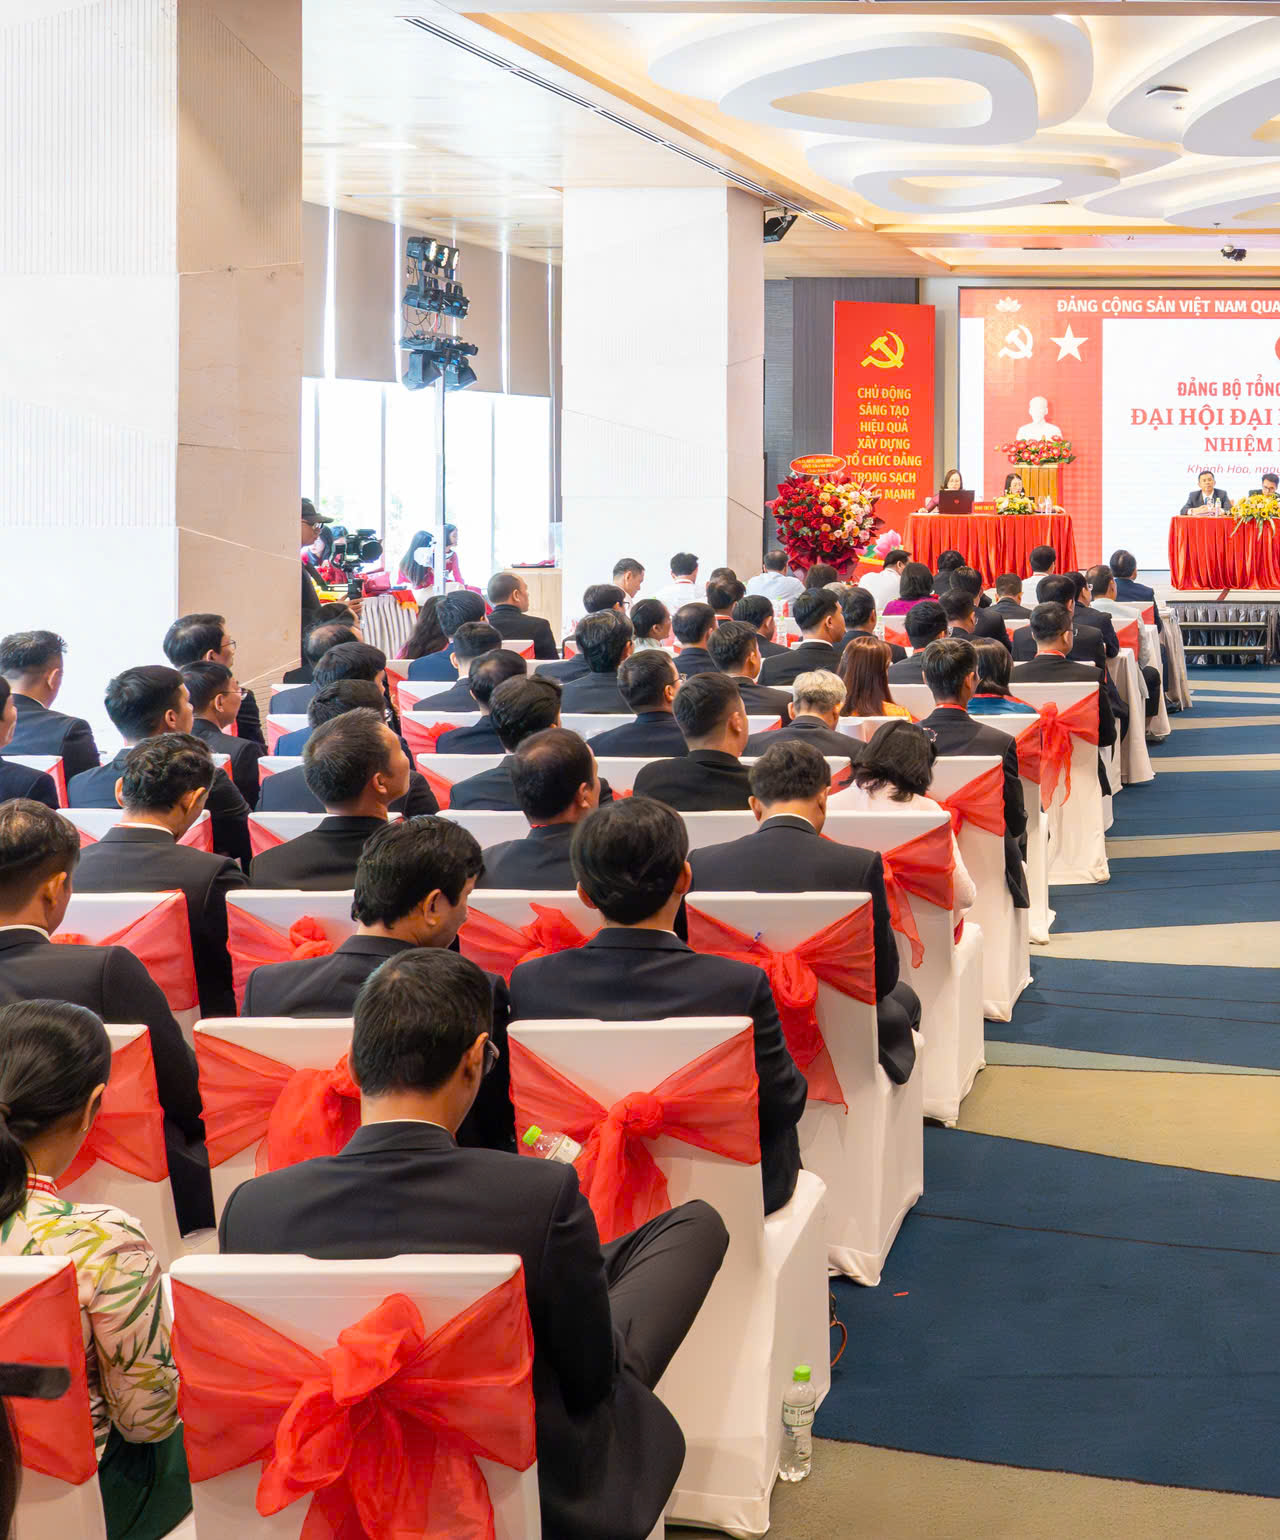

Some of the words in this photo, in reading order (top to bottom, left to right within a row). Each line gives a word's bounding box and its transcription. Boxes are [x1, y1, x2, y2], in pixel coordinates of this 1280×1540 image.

[1057, 296, 1098, 312] ĐẢNG
[1102, 296, 1142, 316] CỘNG
[1146, 296, 1175, 312] SẢN
[1179, 296, 1210, 316] VIỆT
[1215, 300, 1247, 312] NAM
[858, 384, 879, 398] CHỦ
[882, 386, 911, 402] ĐỘNG
[1177, 376, 1218, 396] ĐẢNG
[1222, 378, 1241, 400] BỘ
[859, 402, 887, 416] SÁNG
[890, 405, 909, 419] TẠO
[1130, 408, 1174, 430] ĐẠI
[1179, 404, 1224, 430] HỘI
[1230, 408, 1273, 430] ĐẠI
[860, 419, 884, 435] HIỆU
[887, 418, 908, 433] QUẢ
[858, 435, 878, 448] XÂY
[880, 439, 910, 452] DỰNG
[1204, 434, 1273, 456] NHIỆM
[846, 450, 859, 466] TỔ
[862, 452, 891, 466] CHỨC
[893, 451, 922, 466] ĐẢNG
[851, 472, 887, 483] TRONG
[889, 472, 916, 485] SẠCH
[885, 489, 915, 503] MẠNH
